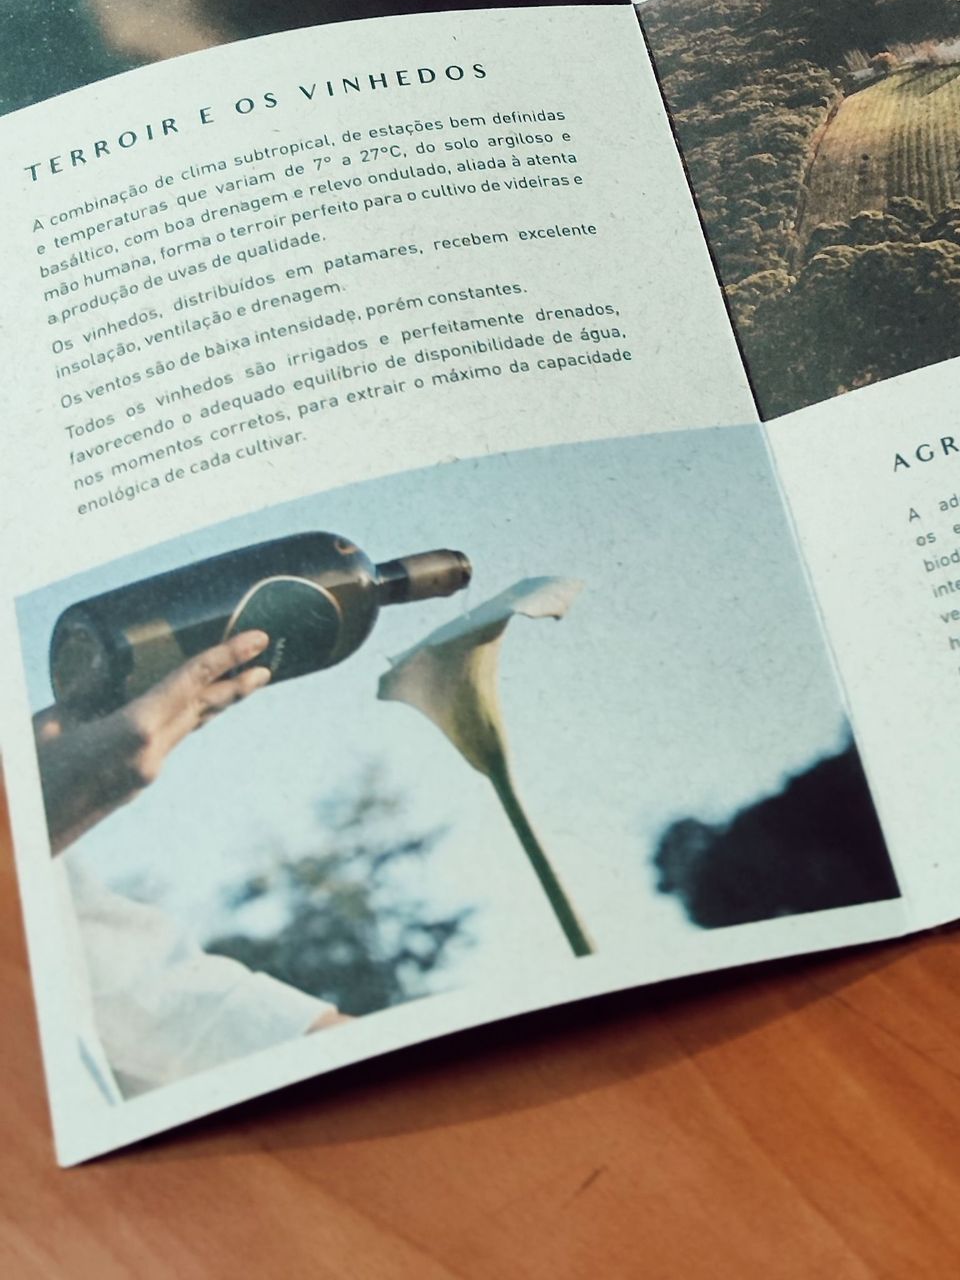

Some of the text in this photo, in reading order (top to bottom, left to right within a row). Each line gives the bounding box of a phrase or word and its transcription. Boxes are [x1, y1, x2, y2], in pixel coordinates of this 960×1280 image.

[23, 62, 486, 181] TERROIR E OS VINHEDOS
[32, 108, 566, 233] A combinação de clima subtropical, de estações bem definidas
[35, 244, 46, 255] e
[53, 200, 168, 248] temperaturas
[175, 188, 207, 208] que
[214, 171, 276, 194] variam
[283, 163, 305, 177] de
[341, 155, 352, 166] a
[414, 140, 436, 154] do
[443, 136, 479, 151] solo
[486, 131, 553, 149] argiloso
[560, 131, 571, 142] e
[38, 152, 577, 278] basáltico, com boa drenagem e relevo ondulado, aliada à atenta
[51, 223, 597, 354] Os vinhedos, distribuídos em patamares, recebem excelente
[55, 282, 346, 379] insolação, ventilação e drenagem.
[63, 302, 620, 439] Todos os vinhedos são irrigados e perfeitamente drenados,
[68, 326, 626, 465] favorecendo o adequado equilíbrio de disponibilidade de água,
[73, 347, 632, 490] nos momentos corretos, para extrair o máximo da capacidade
[907, 506, 921, 523] A
[914, 531, 937, 547] os
